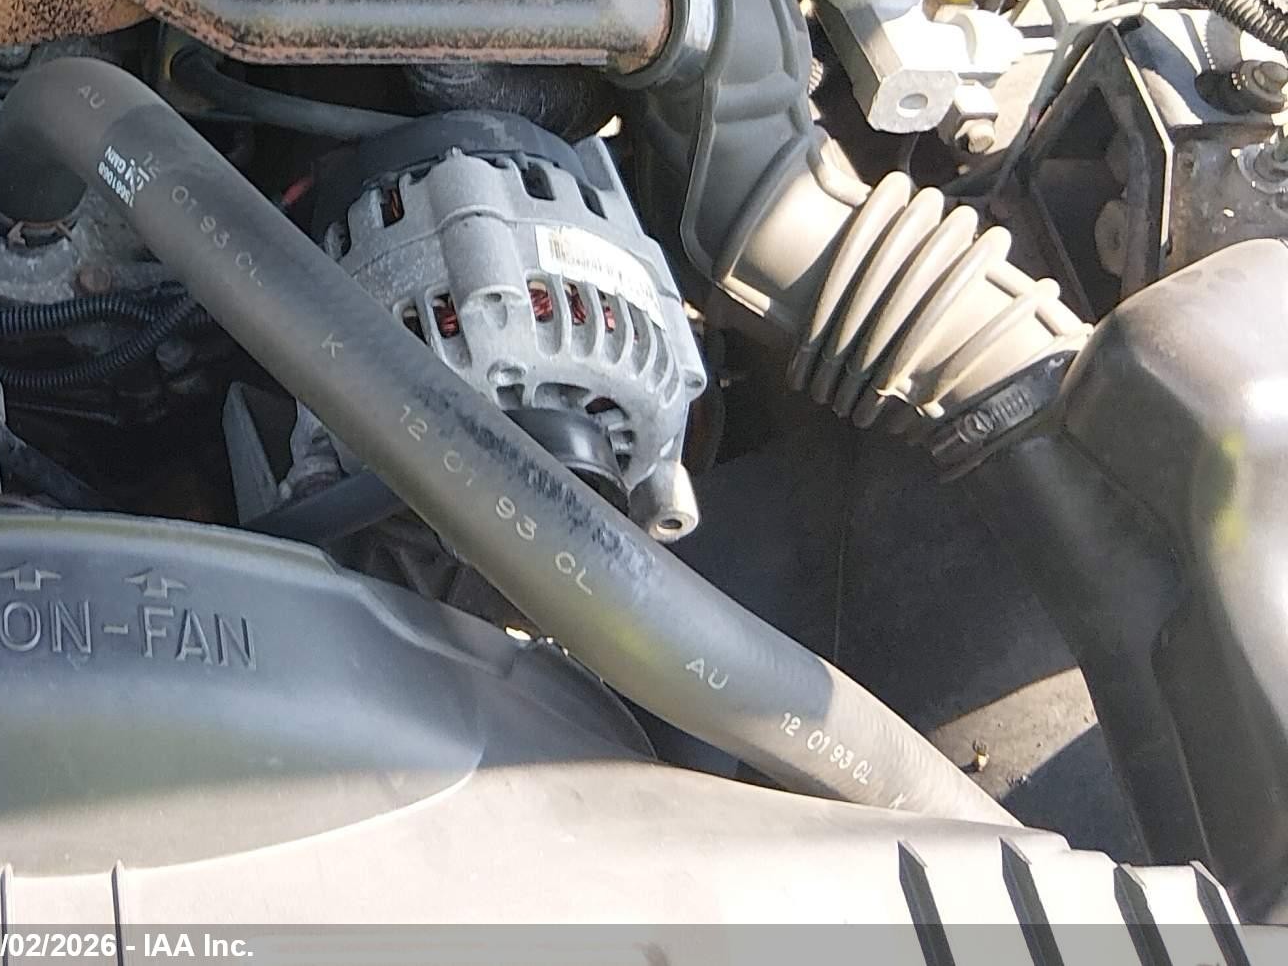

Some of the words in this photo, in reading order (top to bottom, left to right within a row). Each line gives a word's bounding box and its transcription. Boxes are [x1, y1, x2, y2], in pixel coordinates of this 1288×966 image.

[77, 84, 105, 110] AU
[200, 215, 230, 249] 93
[321, 333, 344, 359] K
[399, 404, 429, 442] 12
[495, 496, 538, 542] 93
[555, 550, 593, 596] CL
[685, 657, 729, 691] AU
[779, 712, 802, 737] 12
[806, 729, 831, 755] 01
[829, 743, 855, 770] 93
[852, 759, 874, 785] CL
